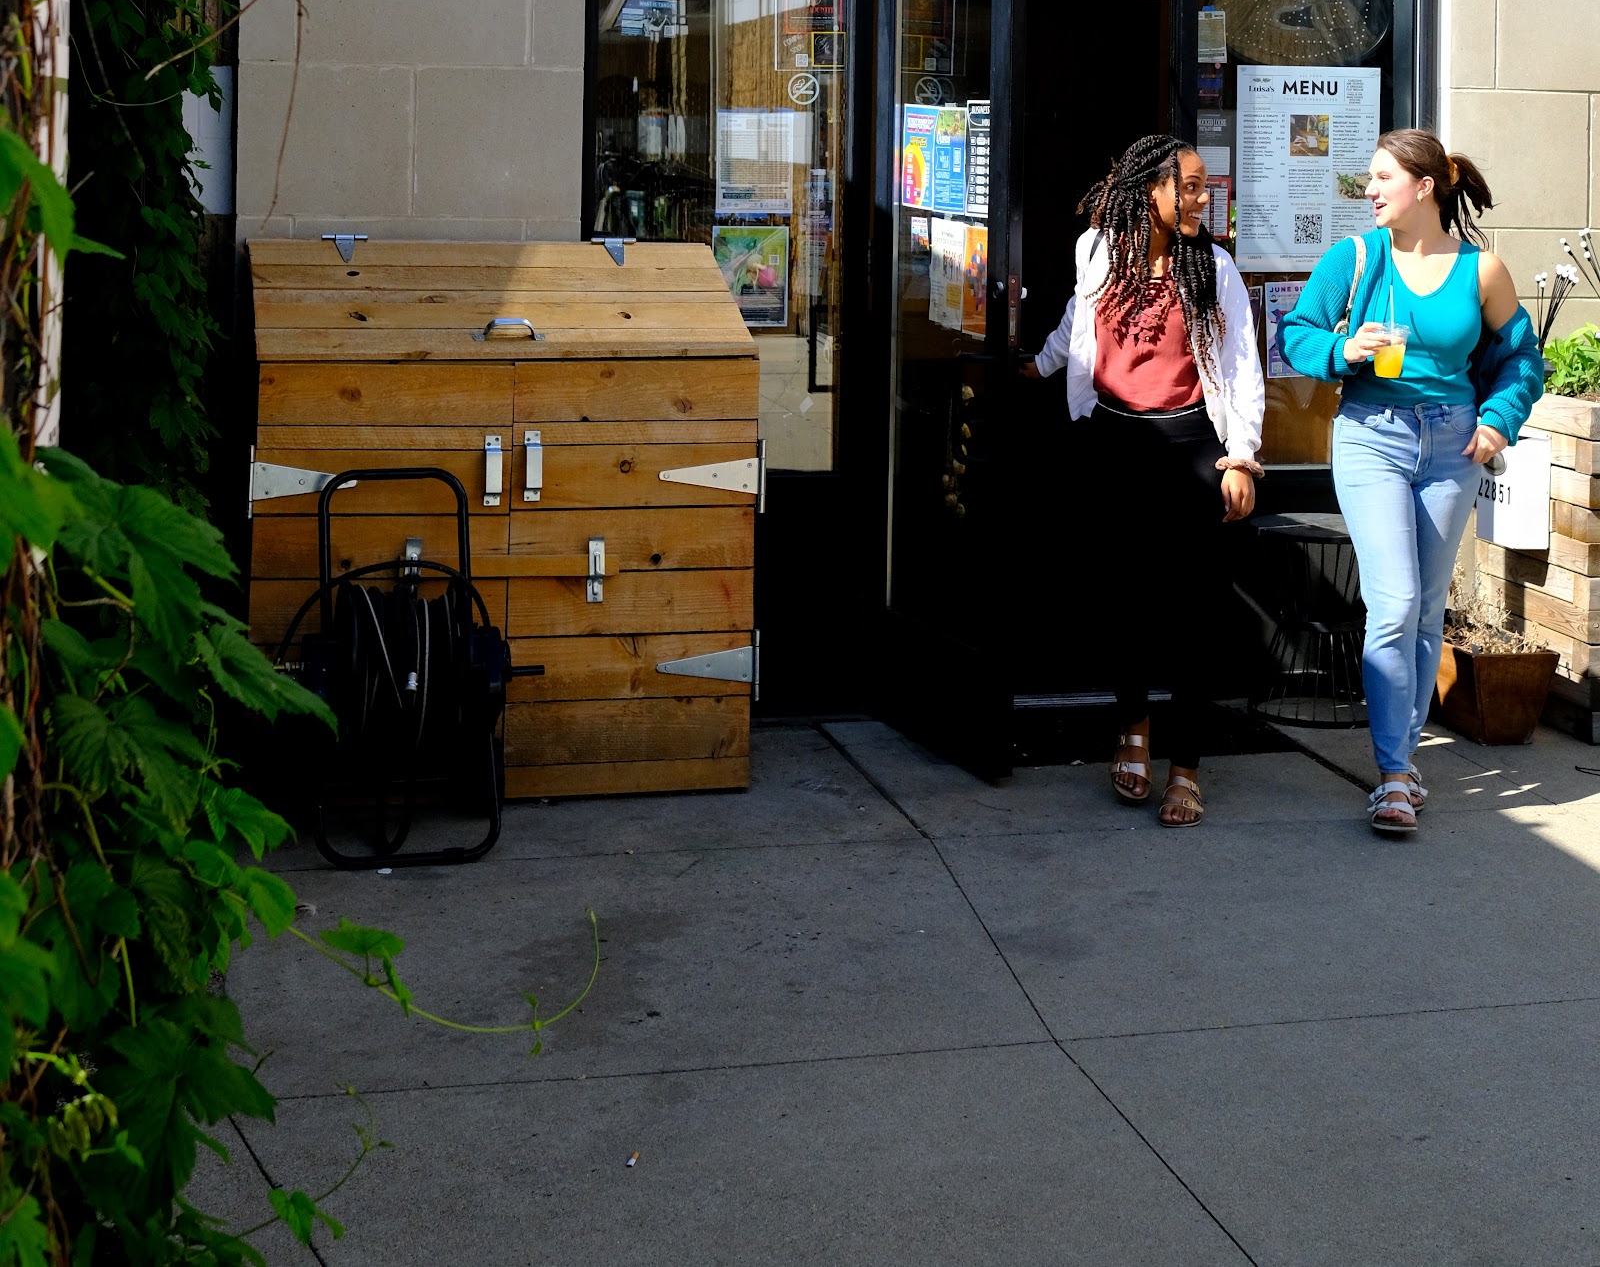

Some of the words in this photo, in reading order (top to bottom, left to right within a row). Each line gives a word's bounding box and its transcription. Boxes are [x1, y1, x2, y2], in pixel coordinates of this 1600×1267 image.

[1248, 85, 1275, 93] Luisa's
[1282, 79, 1338, 96] MENU
[1478, 477, 1511, 505] 22851
